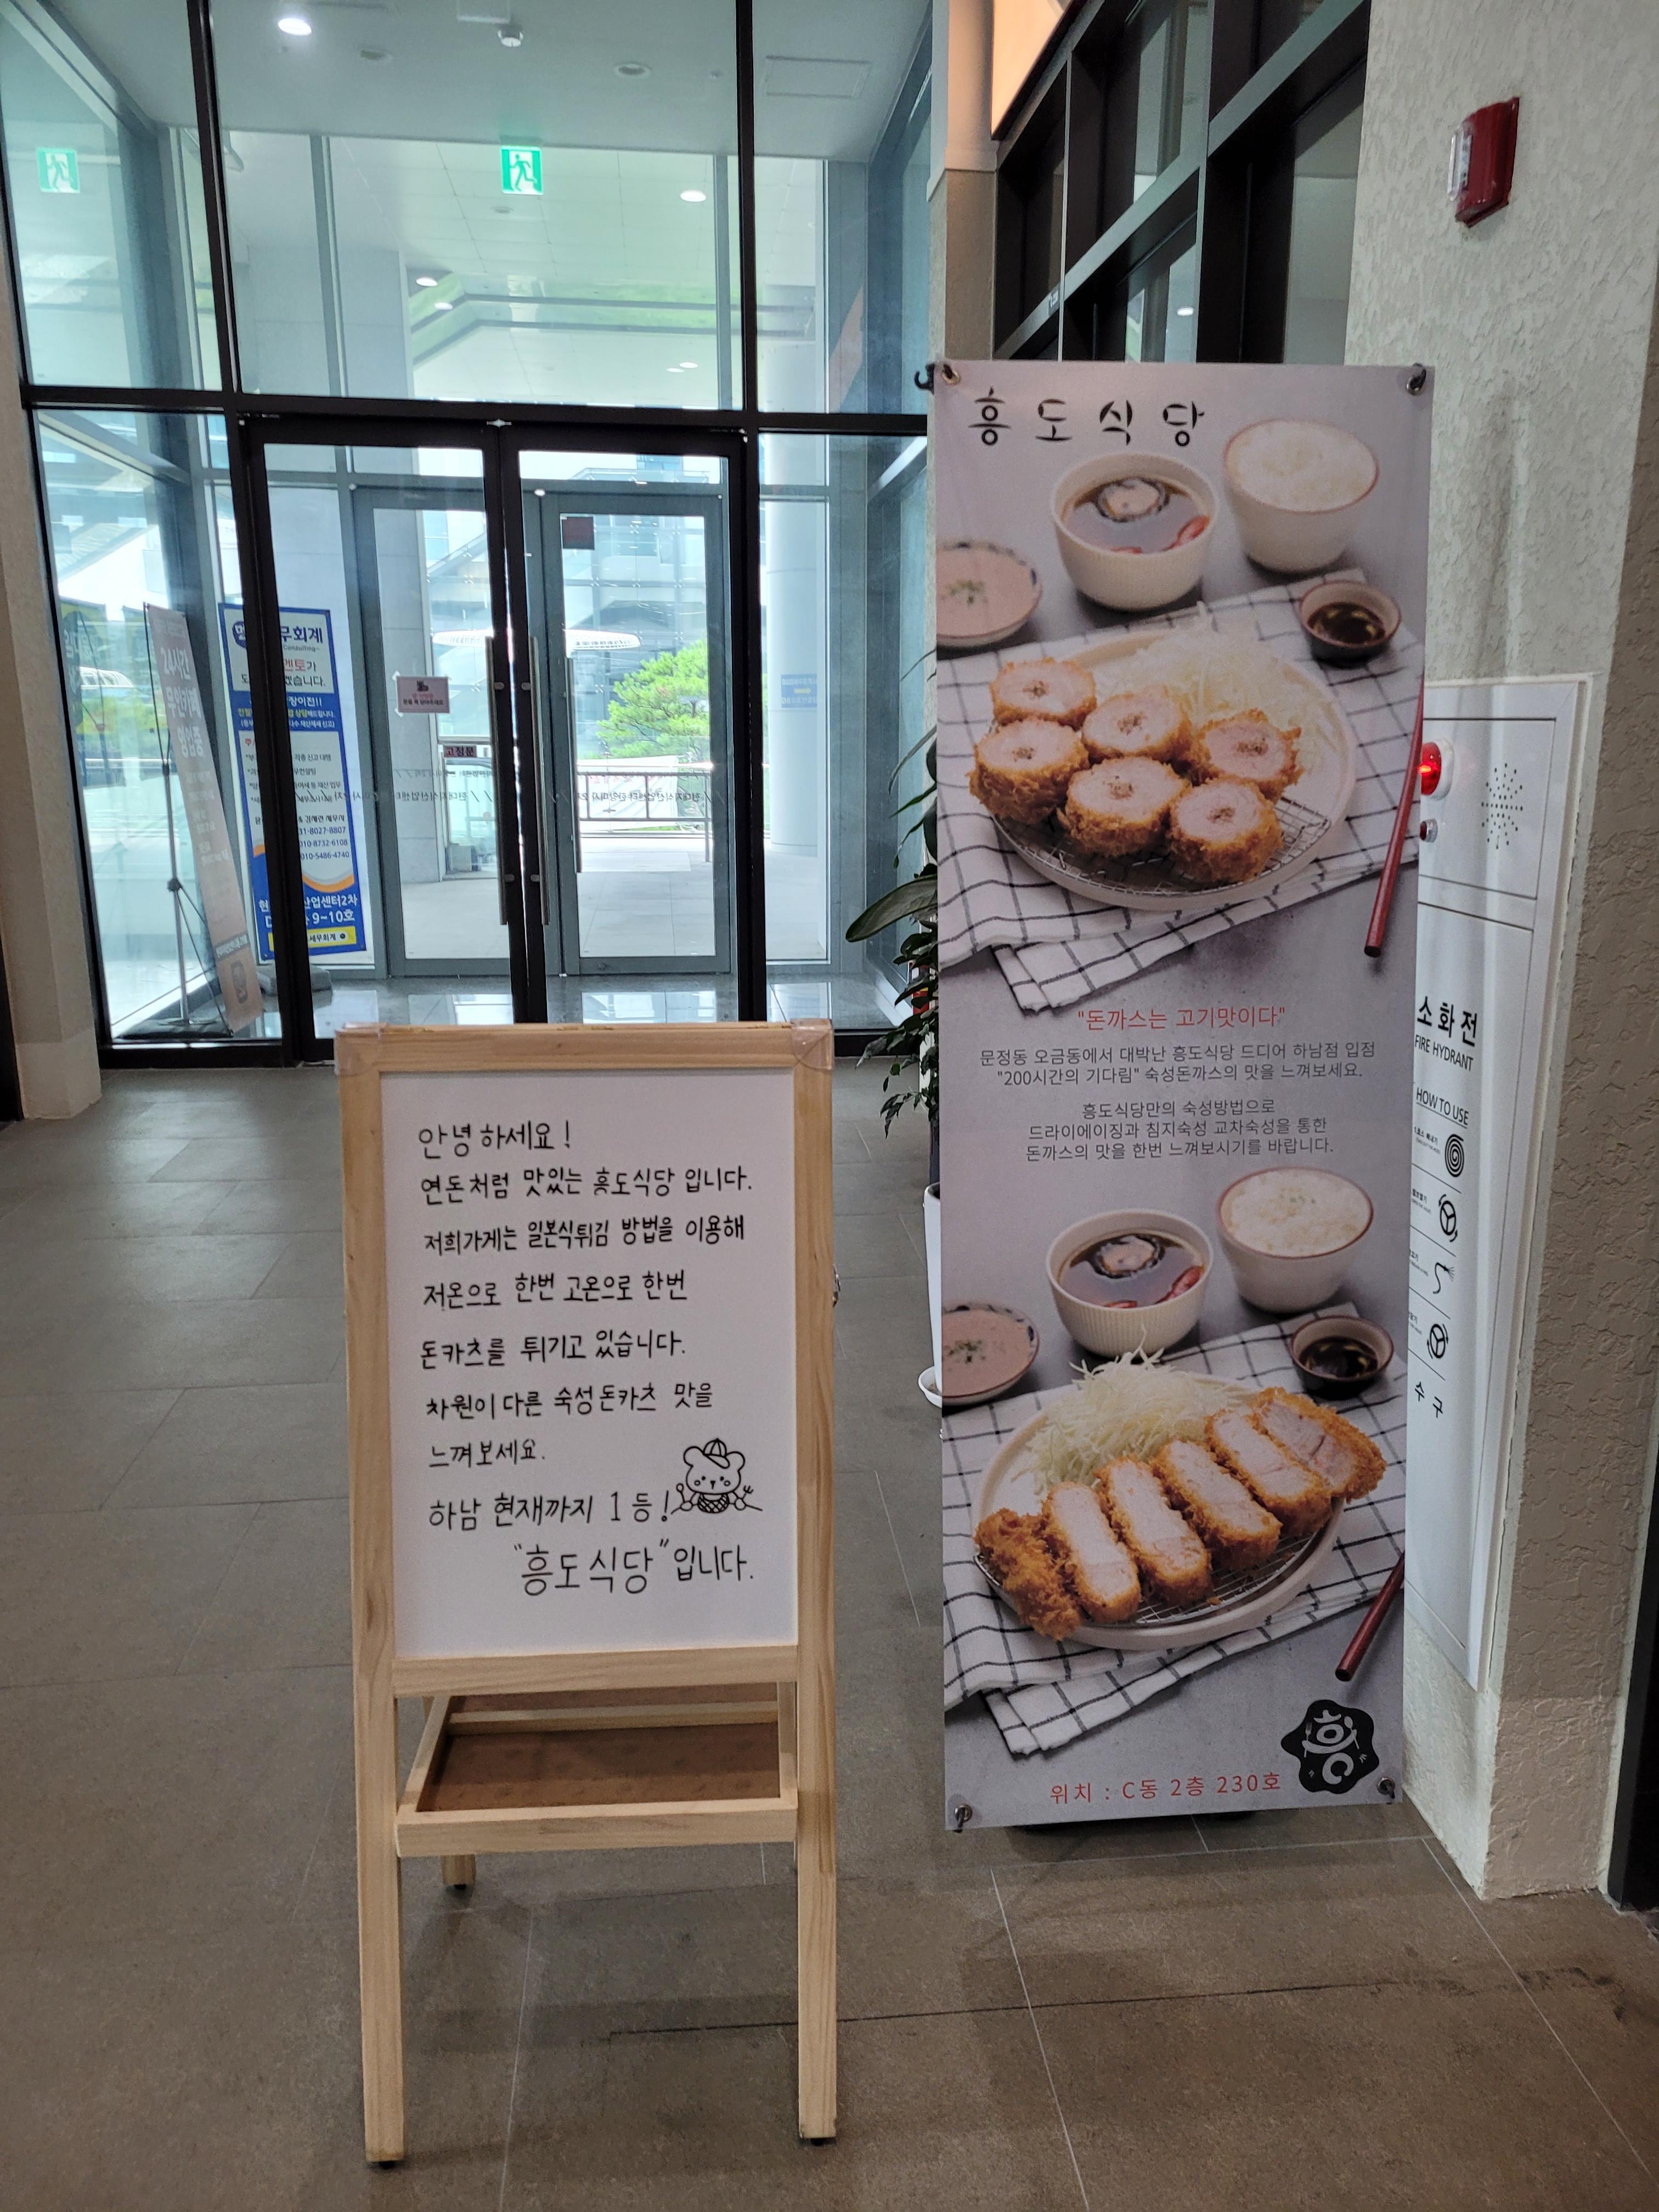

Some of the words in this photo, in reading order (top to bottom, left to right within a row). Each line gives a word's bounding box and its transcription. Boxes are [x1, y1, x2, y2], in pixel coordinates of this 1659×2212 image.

[968, 386, 1205, 447] 흥도식당
[446, 746, 474, 757] 고정문
[1077, 1008, 1167, 1030] "돈까스는
[1176, 1006, 1285, 1028] 고기맛이다"
[1417, 996, 1477, 1047] 소화전
[980, 1049, 1027, 1066] 문정동
[1034, 1047, 1112, 1065] 오금동에서
[1120, 1046, 1166, 1063] 대박난
[1172, 1044, 1235, 1062] 흥도식당
[1240, 1043, 1285, 1059] 드디어
[1293, 1042, 1338, 1059] 하남점
[1345, 1041, 1374, 1058] 입점
[1414, 1034, 1431, 1053] FIRE
[1432, 1041, 1474, 1071] HYDRANT
[997, 1068, 1078, 1086] "200시간의
[1086, 1067, 1139, 1085] 기다림"
[1145, 1064, 1237, 1083] 숙성돈까스의
[1245, 1064, 1274, 1080] 맛을
[1281, 1062, 1363, 1079] 느껴보세요.
[1082, 1101, 1175, 1120] 흥도식당만의
[1183, 1099, 1275, 1116] 숙성방법으로
[1417, 1087, 1438, 1109] HOW
[1439, 1098, 1451, 1116] TO
[1453, 1104, 1469, 1125] USE
[419, 1120, 570, 1159] 안녕하세요!
[1029, 1122, 1139, 1141] 드라이에이징과
[1147, 1120, 1206, 1138] 침지숙성
[1214, 1118, 1290, 1135] 교차숙성을
[1297, 1117, 1327, 1134] 통한
[1026, 1144, 1088, 1162] 돈까스의
[1096, 1143, 1125, 1160] 맛을
[1132, 1142, 1161, 1159] 한번
[1169, 1139, 1261, 1156] 느껴보시기를
[1268, 1137, 1333, 1155] 바랍니다.
[421, 1172, 509, 1205] 연돈처럼
[523, 1166, 582, 1197] 맛있는
[685, 1165, 752, 1193] 입니다.
[622, 1215, 673, 1245] 방법을
[685, 1215, 744, 1245] 이용해
[424, 1282, 501, 1309] 저온으로
[515, 1272, 554, 1302] 한번
[563, 1275, 633, 1302] 고온으로
[642, 1269, 687, 1300] 한번
[420, 1338, 505, 1369] 돈카츠를
[520, 1335, 586, 1363] 튀기고
[595, 1329, 685, 1358] 있습니다.
[426, 1393, 495, 1420] 차원이
[503, 1391, 543, 1417] 다른
[674, 1382, 712, 1408] 맛을
[428, 1439, 544, 1468] 느껴보세요.
[429, 1498, 482, 1531] 하남
[494, 1492, 593, 1527] 현재까지
[1050, 1782, 1091, 1804] 위치
[1122, 1780, 1158, 1799] C동
[1171, 1776, 1204, 1796] 2층
[1217, 1771, 1280, 1793] 230호
